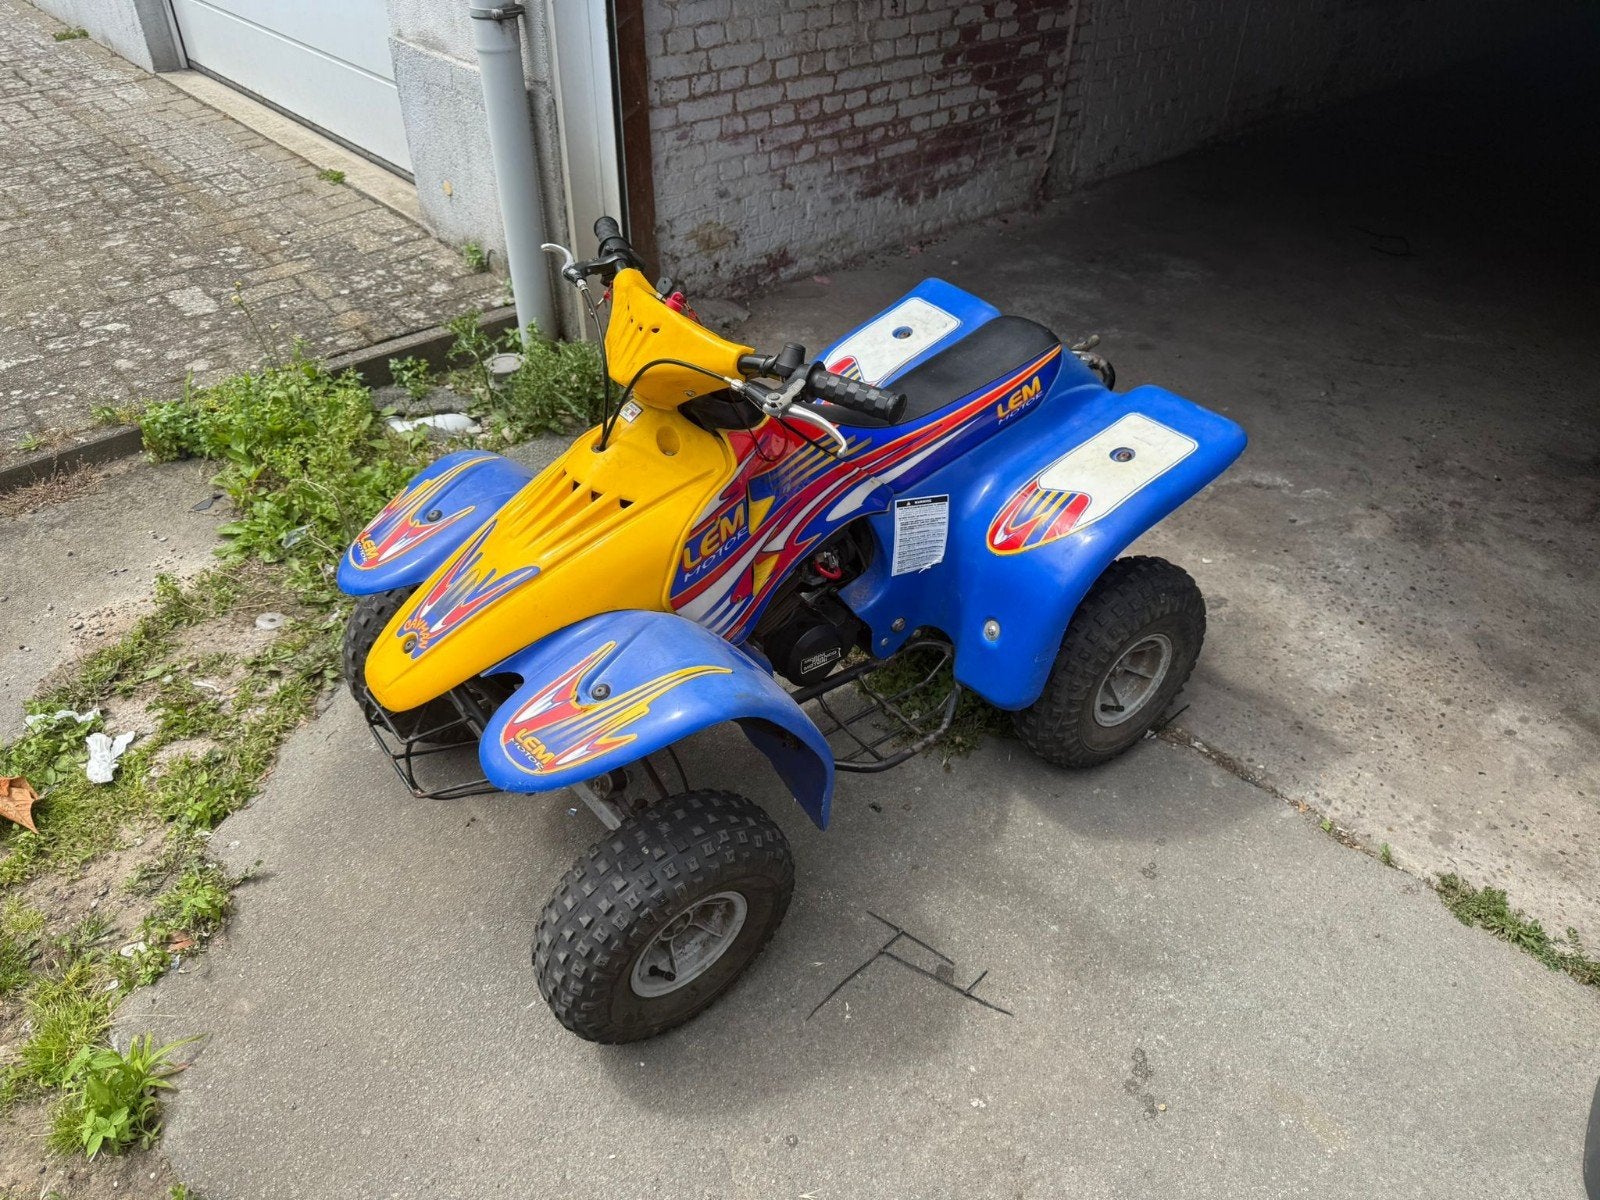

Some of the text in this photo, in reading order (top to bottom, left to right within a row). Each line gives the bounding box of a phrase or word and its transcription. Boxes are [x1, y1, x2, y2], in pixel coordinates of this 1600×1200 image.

[997, 376, 1041, 419] LEM
[361, 534, 380, 560] LEM
[683, 503, 745, 571] LEM
[684, 526, 749, 583] MOTOR
[404, 617, 430, 650] CAYMAN
[511, 738, 544, 771] MOTOR
[514, 728, 555, 766] LEM
